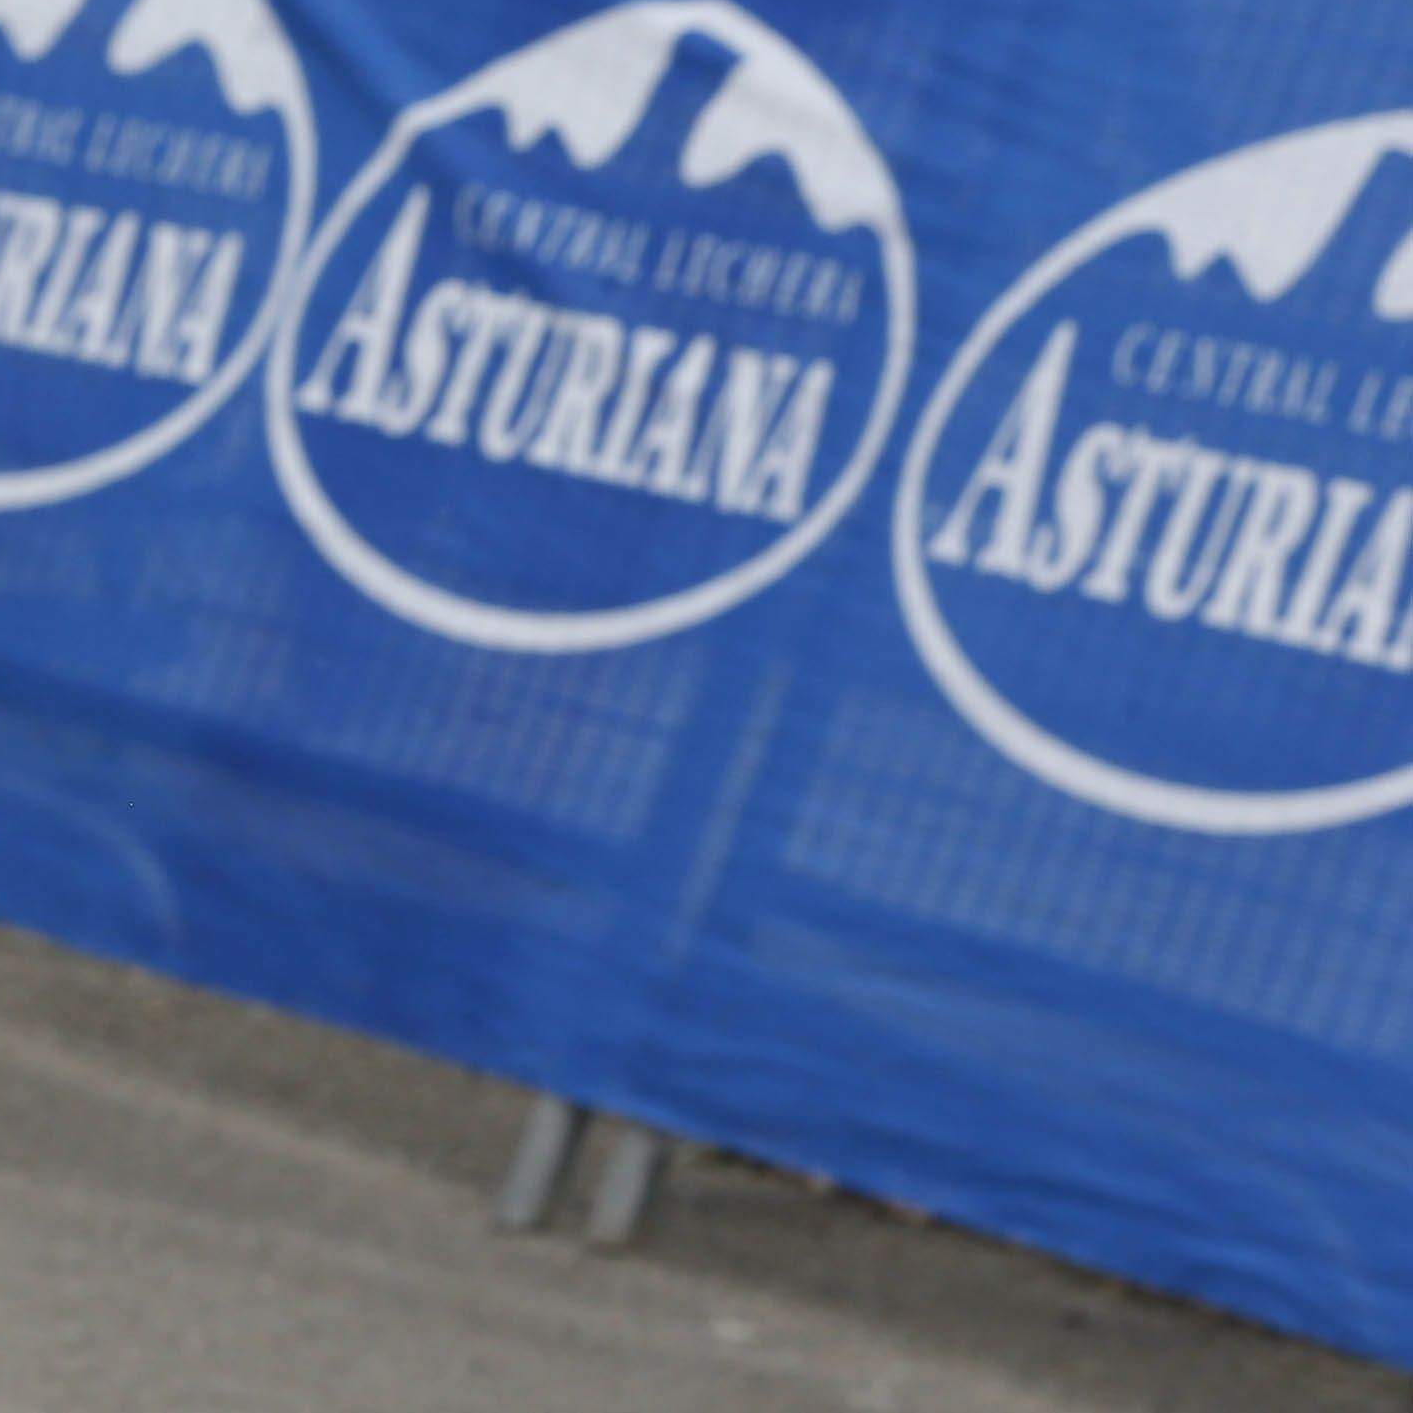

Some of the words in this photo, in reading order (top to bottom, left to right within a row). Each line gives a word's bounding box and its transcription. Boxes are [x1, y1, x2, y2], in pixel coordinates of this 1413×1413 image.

[295, 185, 836, 525] ASTURIANA
[930, 318, 1413, 674] ASTURIA
[1111, 320, 1339, 427] CENTRAL
